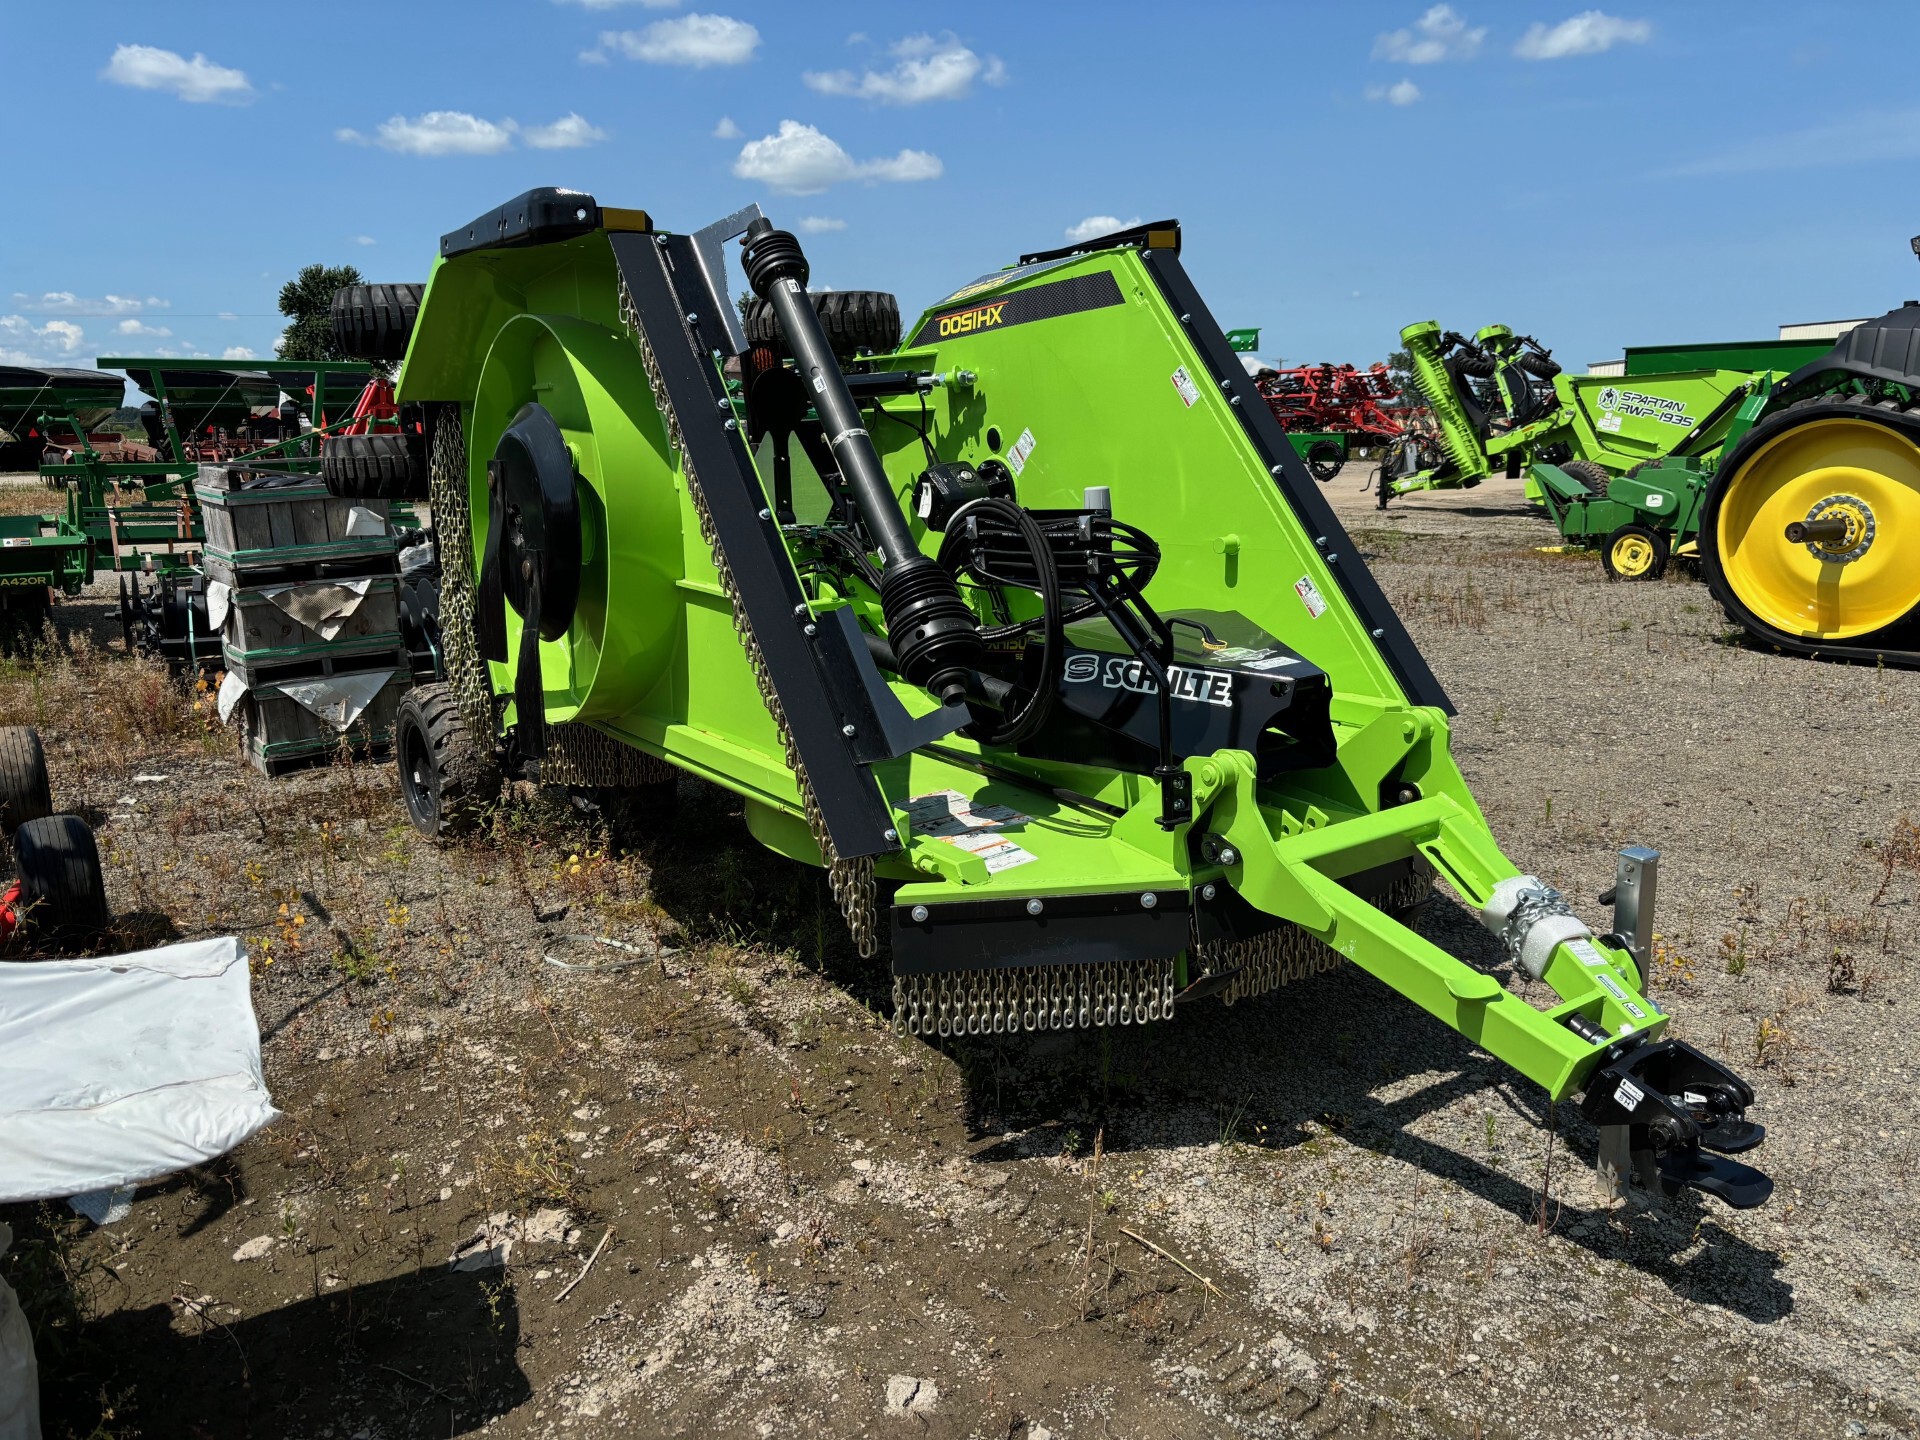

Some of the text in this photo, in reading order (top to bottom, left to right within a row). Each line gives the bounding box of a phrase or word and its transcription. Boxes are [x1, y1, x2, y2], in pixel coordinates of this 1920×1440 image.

[940, 305, 1003, 336] XH1500
[1621, 391, 1685, 412] SPARTAN
[1618, 404, 1694, 427] RWP-1935
